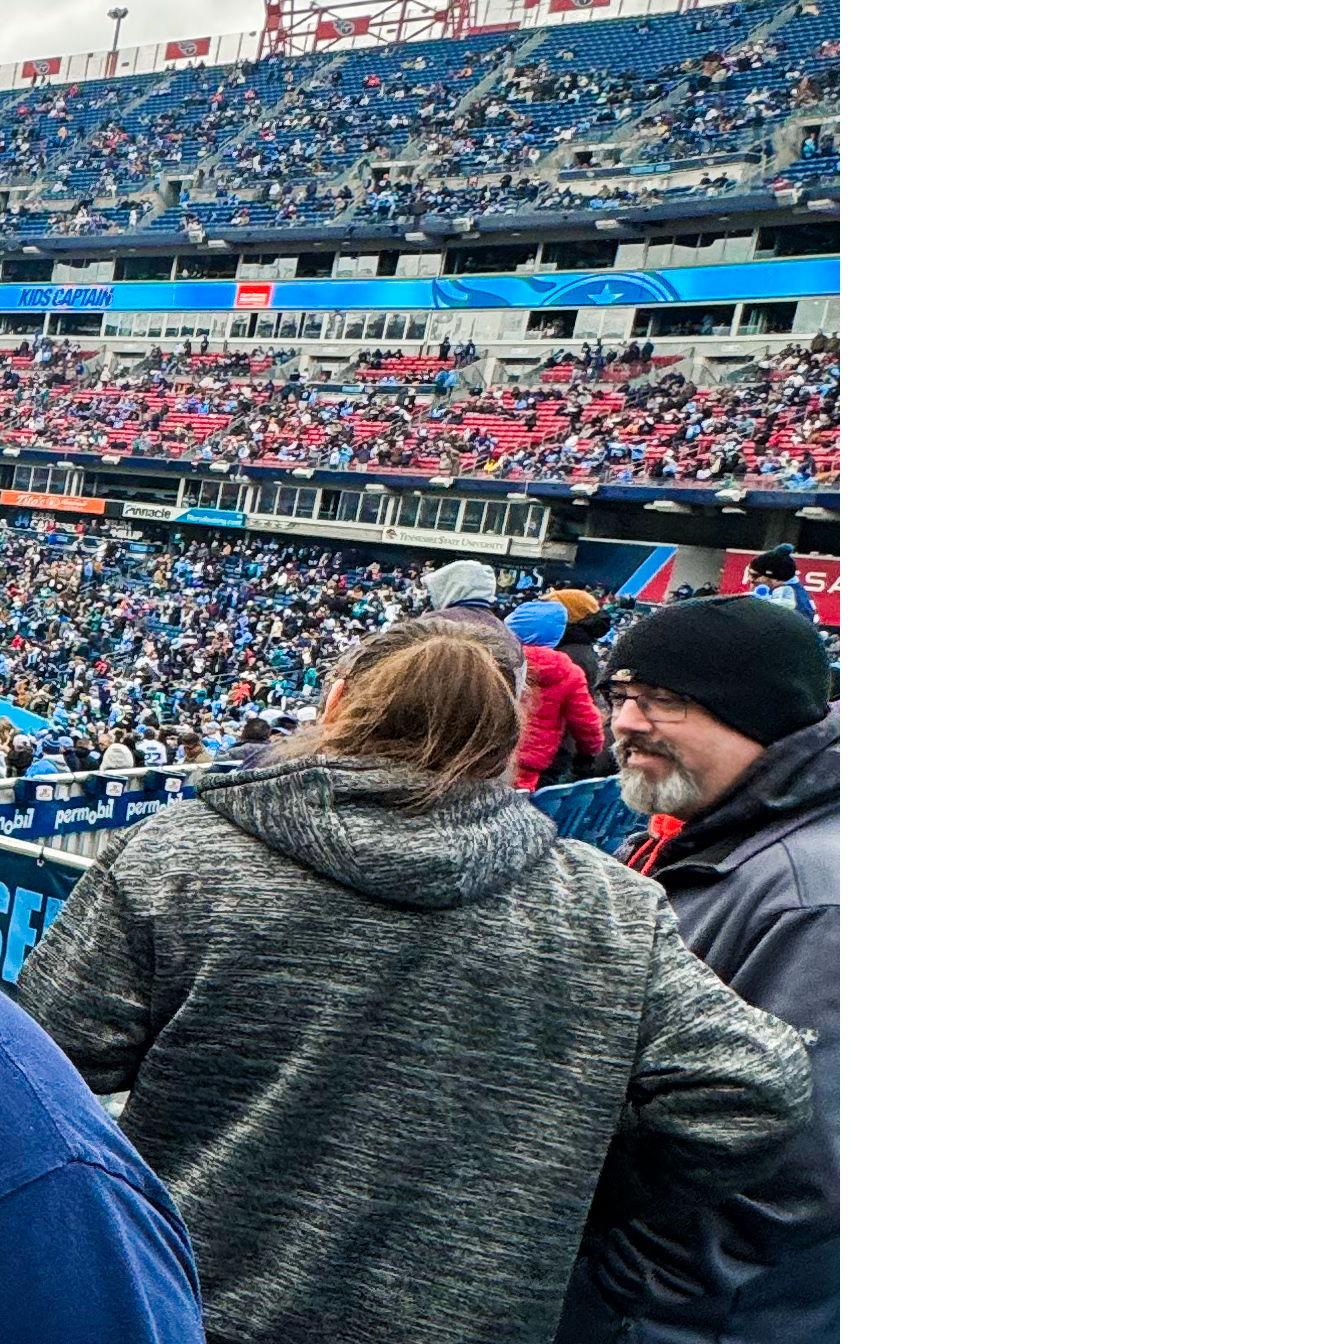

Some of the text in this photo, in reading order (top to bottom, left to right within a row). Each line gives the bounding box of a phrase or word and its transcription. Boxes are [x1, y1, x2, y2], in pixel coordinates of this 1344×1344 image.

[18, 286, 113, 307] KIDS CAPTAIN
[124, 506, 172, 520] Pinnacle
[55, 798, 114, 829] permobil
